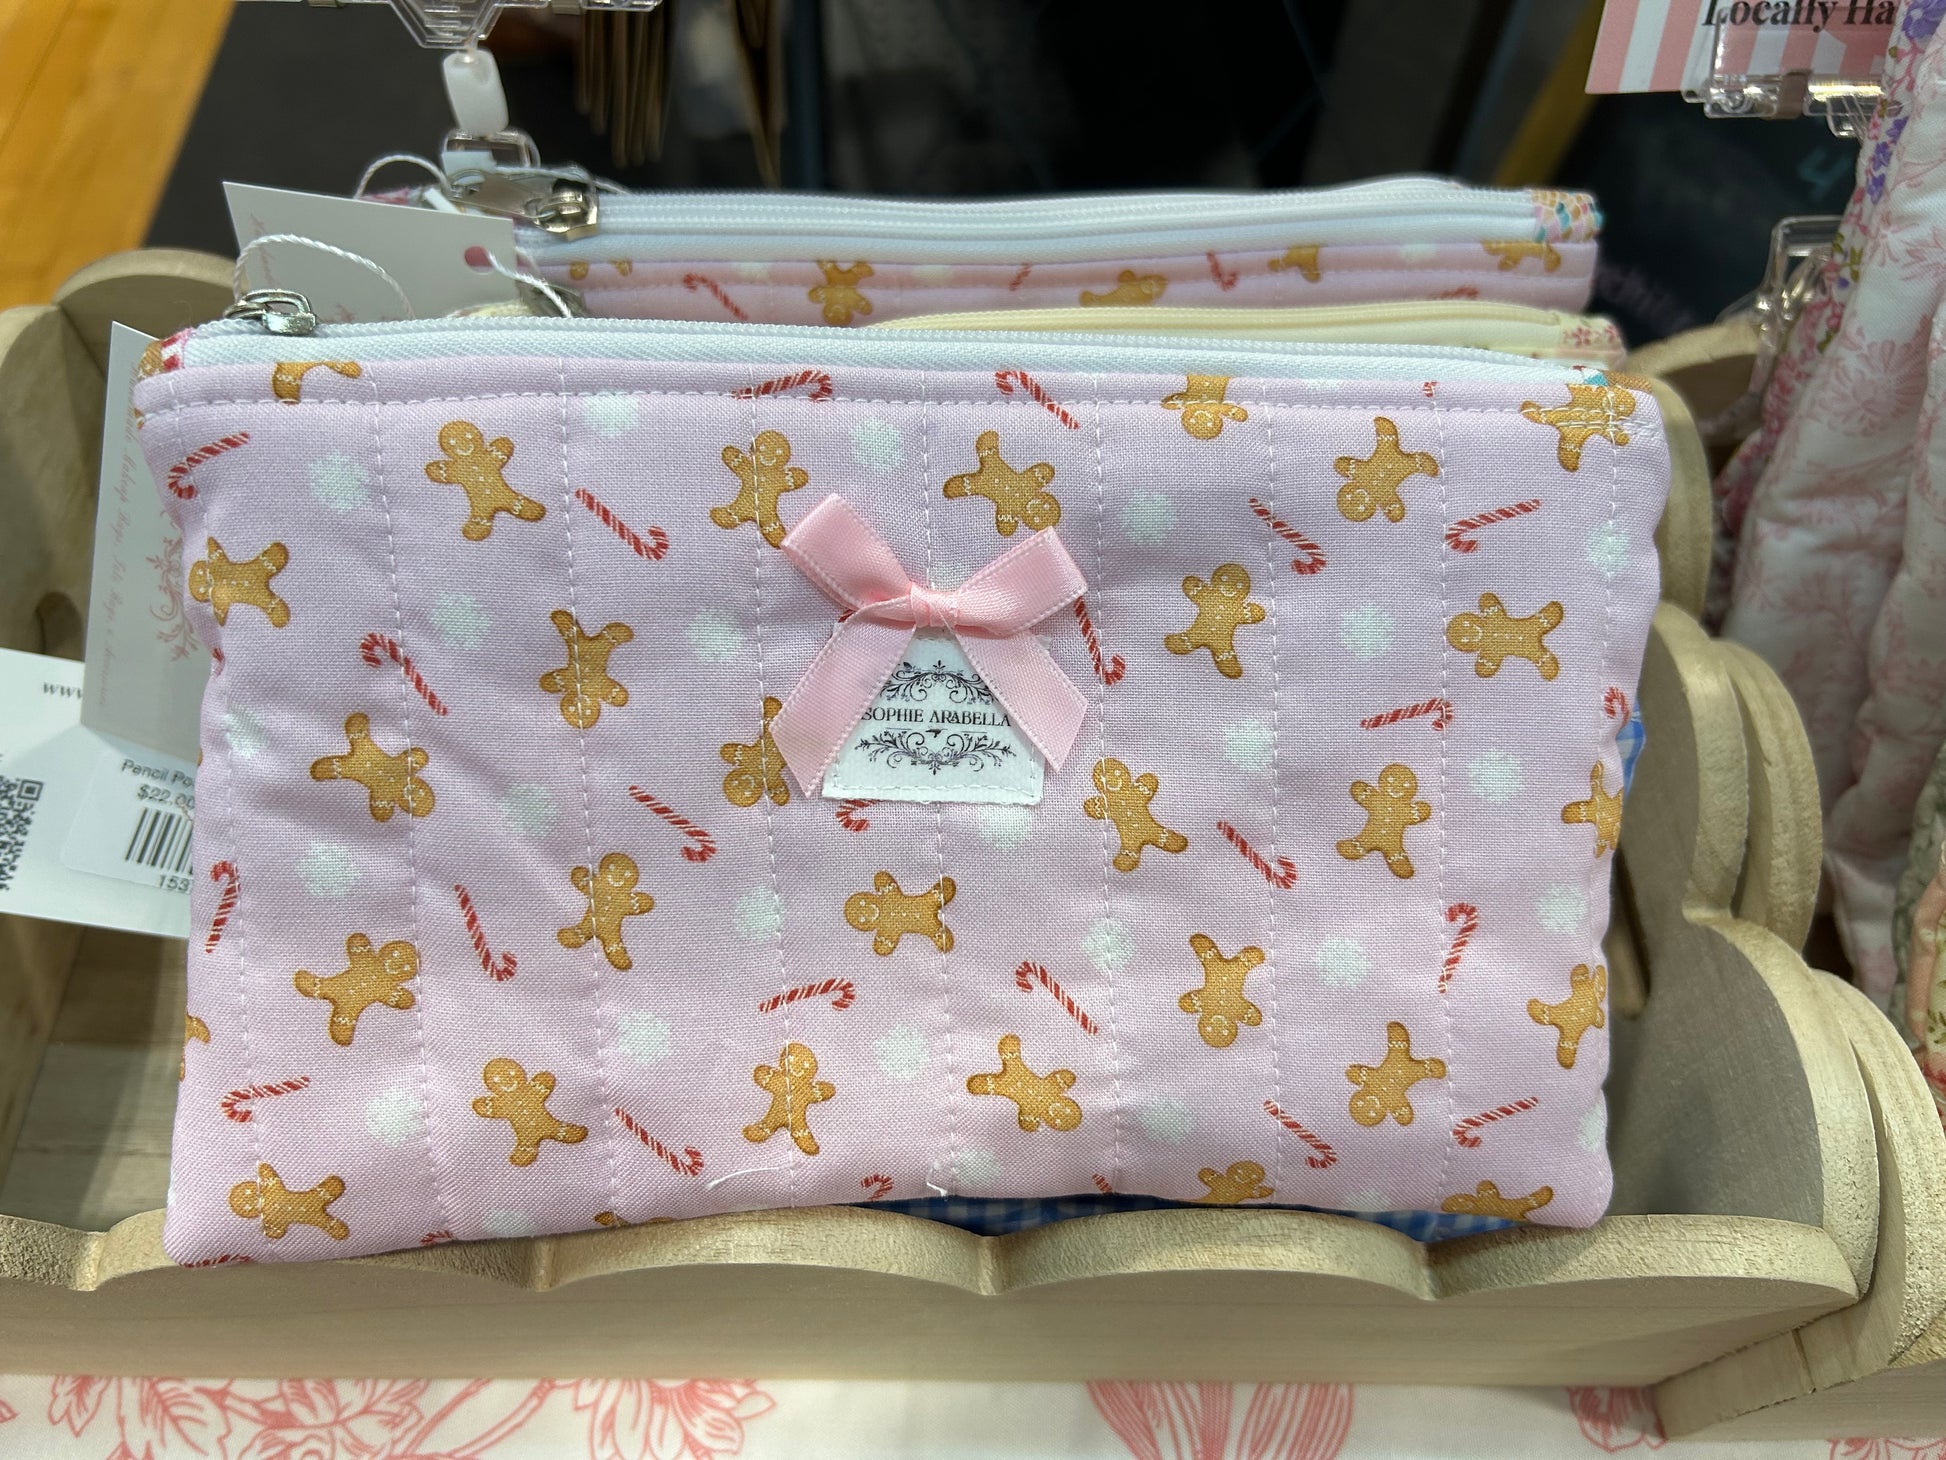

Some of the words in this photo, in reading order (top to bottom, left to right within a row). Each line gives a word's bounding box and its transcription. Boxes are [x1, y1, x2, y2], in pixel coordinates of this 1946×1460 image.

[1701, 0, 1836, 32] Locally
[861, 706, 924, 723] SOPHIE
[929, 710, 1012, 728] ARABELLA
[121, 758, 169, 781] Pencil
